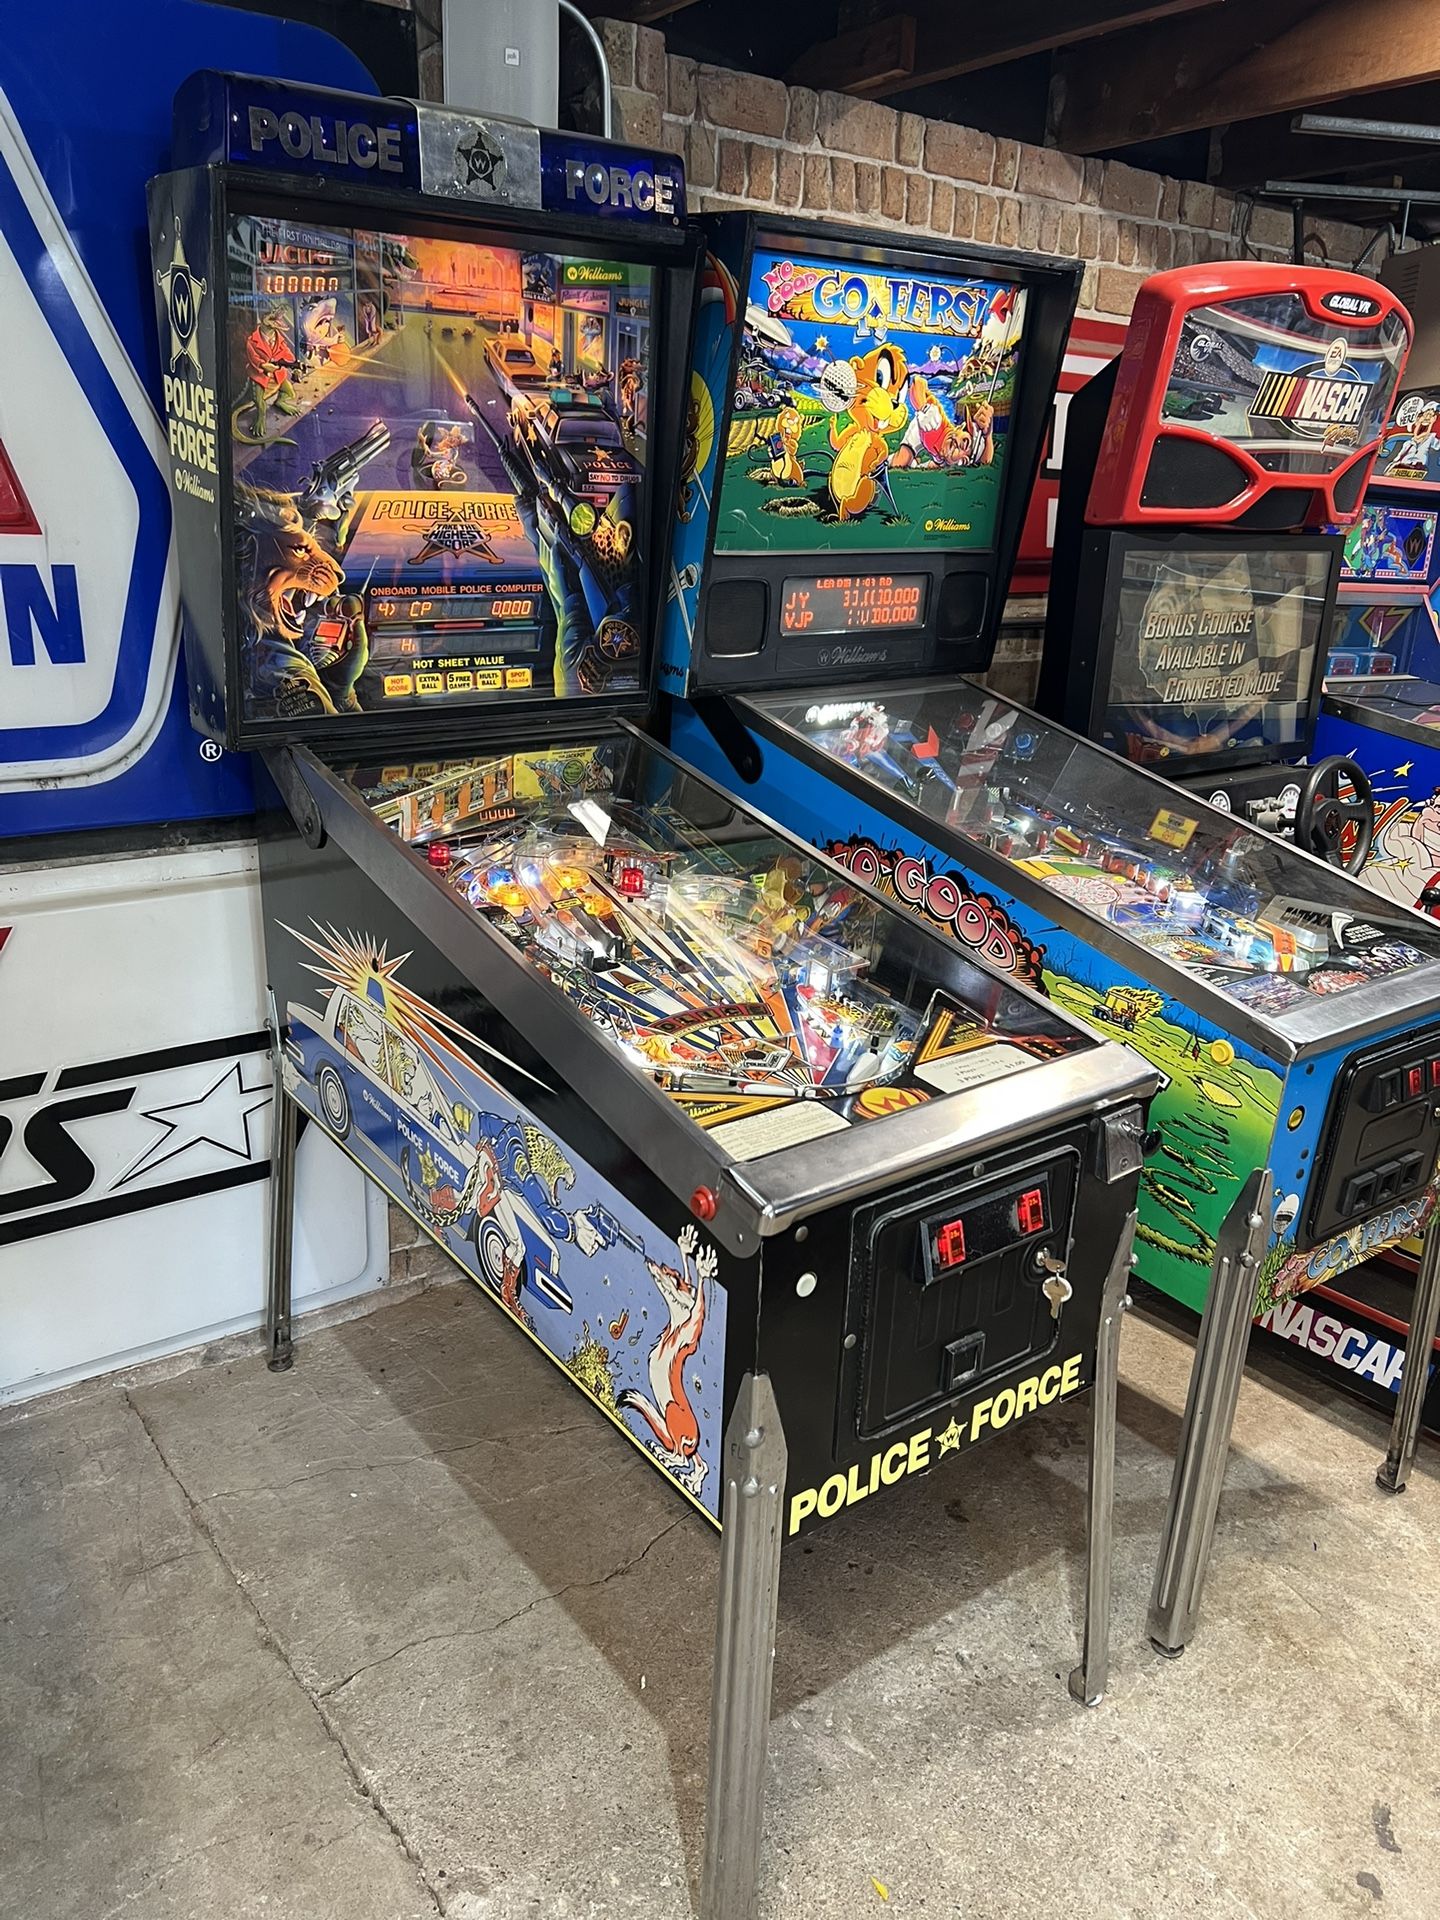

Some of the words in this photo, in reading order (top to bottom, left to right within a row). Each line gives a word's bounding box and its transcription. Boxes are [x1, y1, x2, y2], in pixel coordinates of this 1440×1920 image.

[248, 105, 404, 173] POLICE
[565, 159, 676, 215] FORCE
[577, 265, 623, 281] Williams
[762, 260, 794, 289] NO
[767, 272, 818, 312] GOOD
[1329, 295, 1355, 311] GLOBAL
[1354, 299, 1372, 314] VR
[1197, 339, 1224, 349] GLOBAL
[1330, 346, 1343, 359] EA
[163, 374, 217, 431] POLICE
[1294, 381, 1369, 422] NASCAR
[168, 417, 216, 474] FORCE
[583, 461, 633, 470] POLICE
[589, 473, 600, 481] SAY
[600, 473, 611, 482] NO
[372, 500, 451, 521] POLICE
[461, 502, 520, 522] FORCE
[933, 518, 971, 531] Williams
[428, 530, 485, 541] HIGHEST
[370, 586, 418, 596] ONBOARD
[421, 585, 457, 595] MOBILE
[459, 584, 492, 594] POLICE
[495, 583, 544, 593] COMPUTER
[1144, 612, 1198, 639] BONUS
[1198, 609, 1255, 637] COURSE
[413, 659, 433, 669] HOT
[438, 657, 471, 668] SHEET
[474, 656, 505, 666] VALUE
[831, 645, 888, 666] Williams
[1155, 643, 1229, 671] AVAILABLE
[1228, 640, 1246, 665] IN
[419, 675, 440, 683] EXTRA
[421, 682, 438, 690] BALL
[448, 674, 455, 683] 5
[455, 675, 472, 683] FREE
[449, 682, 471, 690] GAMES
[1163, 673, 1248, 703] CONNECTED
[1246, 670, 1284, 695] MODE
[397, 1119, 424, 1152] POLICE
[433, 1151, 460, 1180] FORCE
[789, 1427, 933, 1537] POLICE
[970, 1353, 1083, 1442] FORCE
